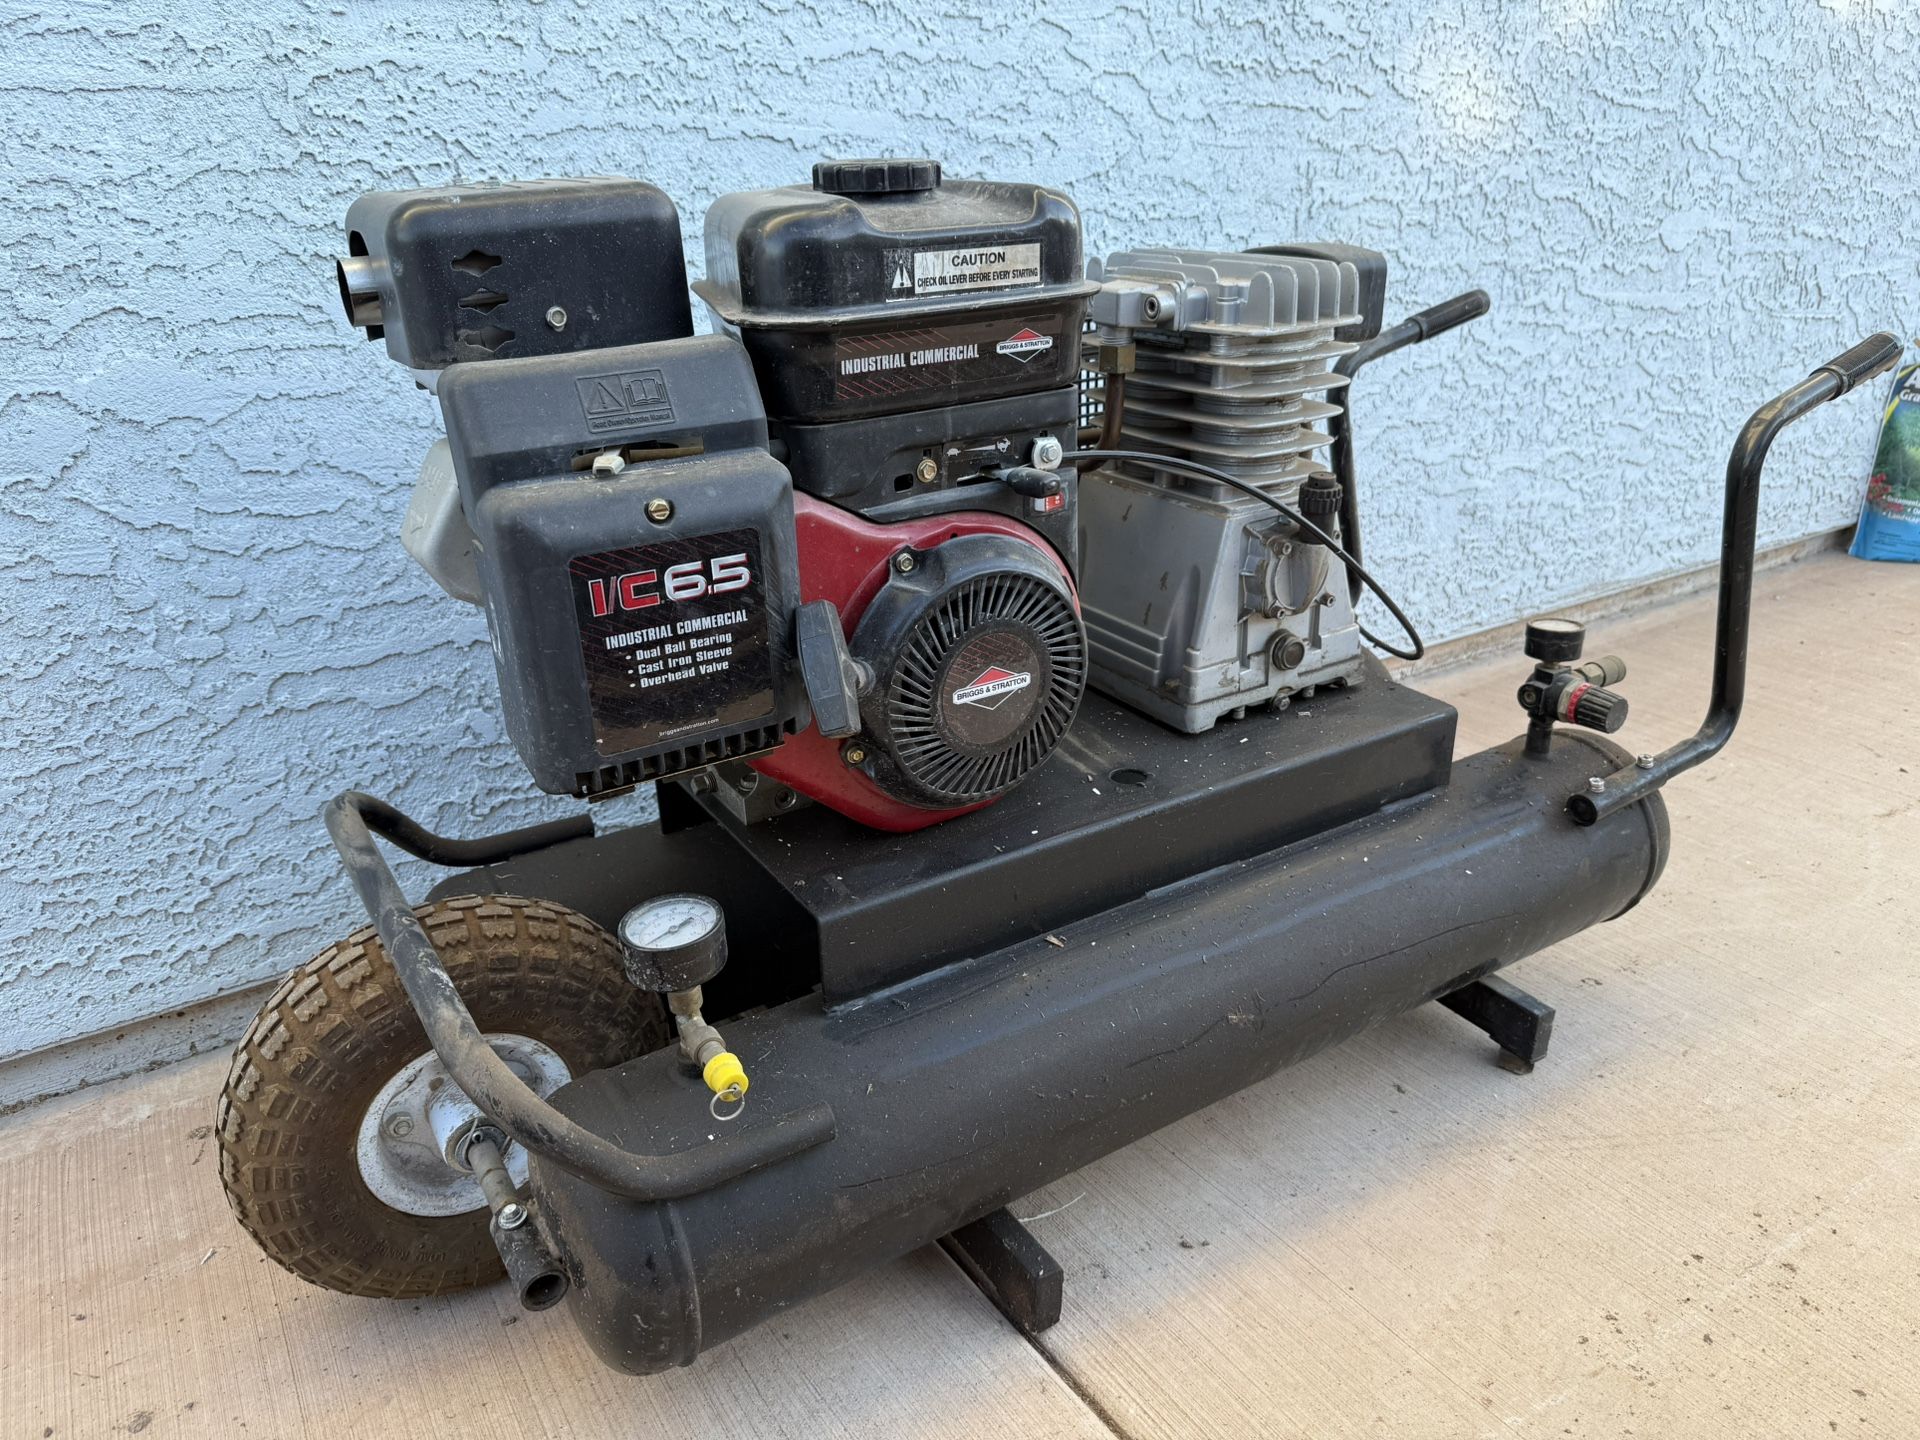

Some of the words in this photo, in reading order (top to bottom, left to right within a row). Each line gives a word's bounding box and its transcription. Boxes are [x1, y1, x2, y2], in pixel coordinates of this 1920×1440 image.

[951, 251, 1006, 267] CAUTION
[917, 277, 937, 288] CHECK
[939, 276, 949, 286] OIL
[949, 273, 967, 285] LEVER
[968, 272, 991, 283] BEFORE
[992, 270, 1010, 281] EVERY
[1012, 267, 1039, 279] STARTING
[841, 354, 907, 376] INDUSTRIAL
[909, 343, 980, 366] COMMERCIAL
[999, 343, 1019, 351] BRIGGS
[1024, 340, 1050, 349] STRATTON
[588, 568, 661, 618] I/C
[664, 552, 751, 602] 6.5
[605, 624, 674, 650] INDUSTRIAL
[676, 609, 748, 636] COMMERCIAL
[636, 646, 661, 661] Dual
[665, 638, 686, 655] Ball
[690, 631, 733, 648] Bearing
[638, 659, 664, 675] Cast
[668, 655, 692, 668] Iron
[696, 645, 733, 663] Sleeve
[640, 665, 696, 688] Overhead
[699, 660, 729, 675] Valve
[956, 687, 984, 701] BRIGGS
[985, 685, 991, 693] &
[991, 676, 1027, 692] STRATTON
